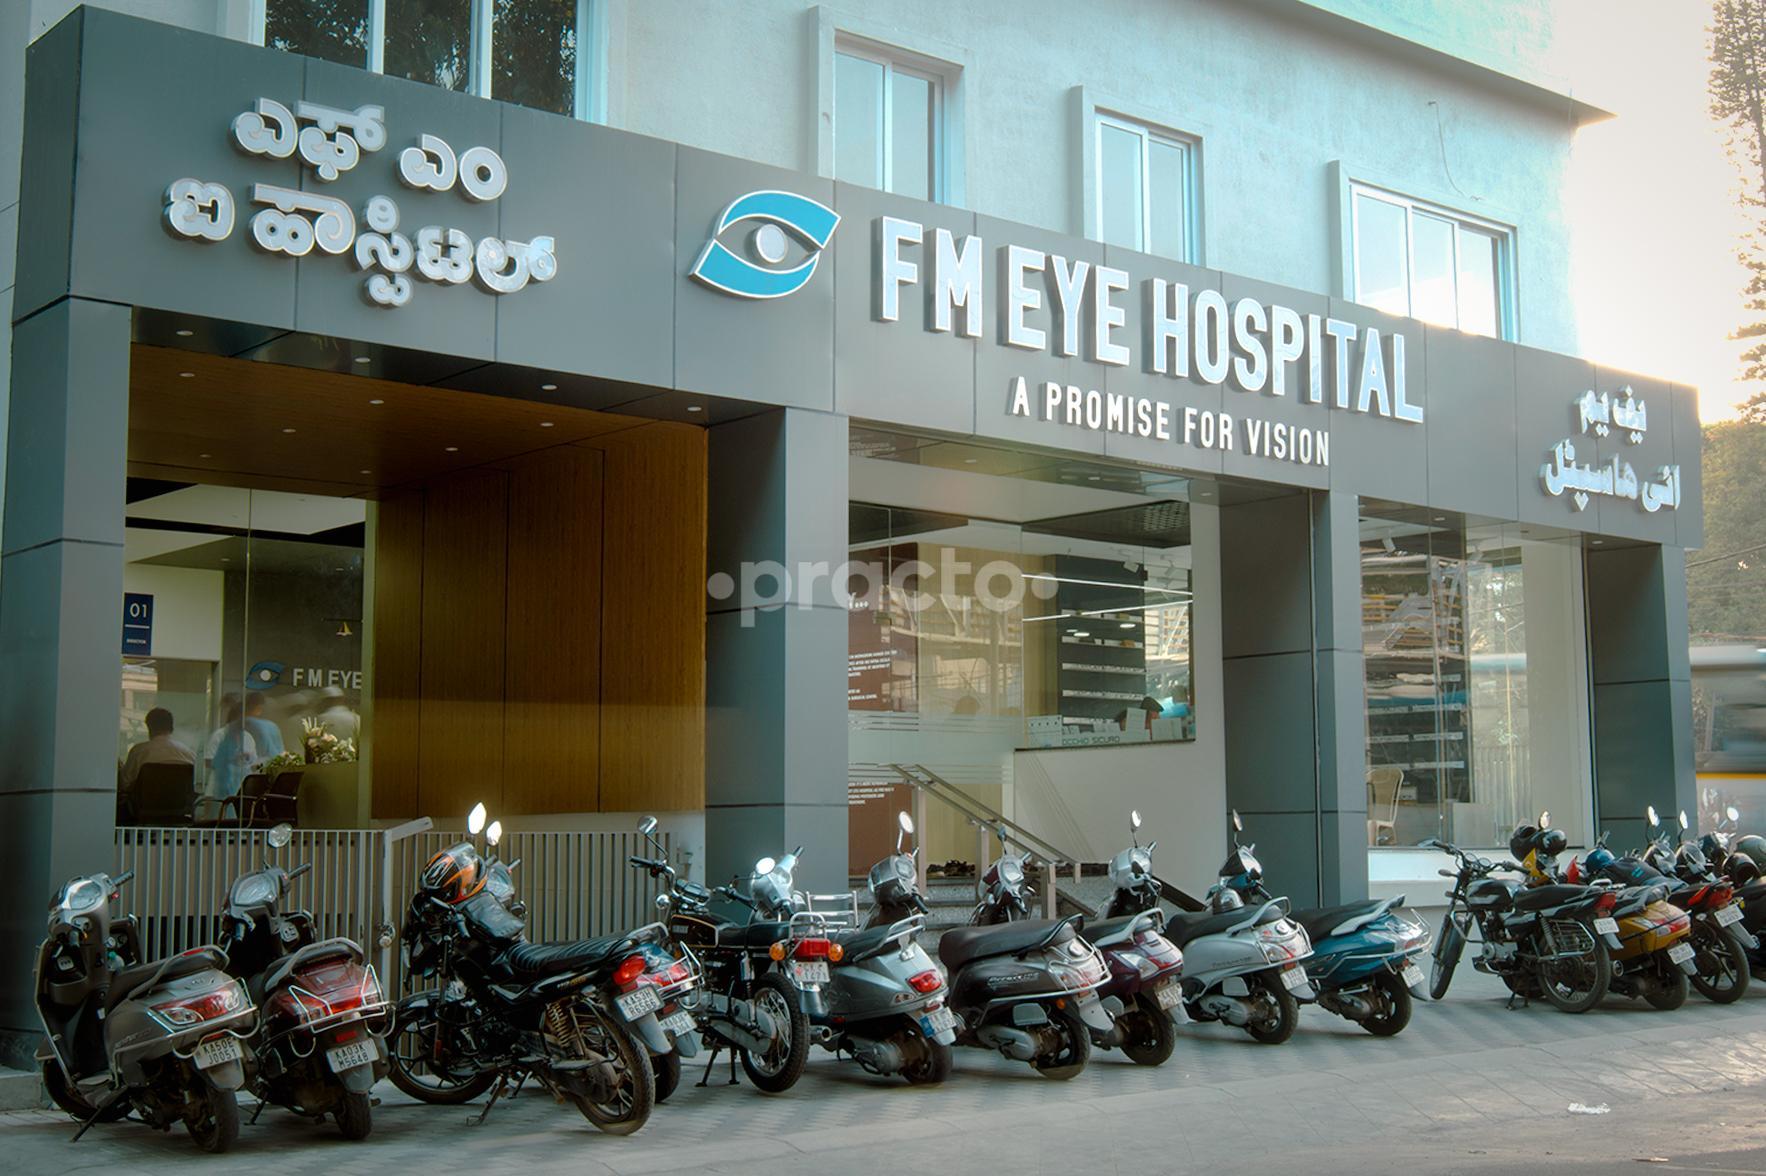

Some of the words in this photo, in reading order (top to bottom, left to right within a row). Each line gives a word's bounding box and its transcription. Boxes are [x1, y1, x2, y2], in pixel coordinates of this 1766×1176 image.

[398, 133, 508, 201] ಎಂ
[164, 177, 236, 242] ಐ
[250, 182, 557, 307] ಹಾಸ್ಪಿಟಲ್
[1003, 244, 1130, 366] EYE
[1150, 277, 1424, 424] HOSPITAL
[1011, 375, 1031, 417] A
[1044, 381, 1170, 441] PROMISE
[1183, 407, 1233, 451] FOR
[1245, 417, 1330, 466] VISION
[129, 602, 148, 618] 01
[327, 668, 362, 689] EYE
